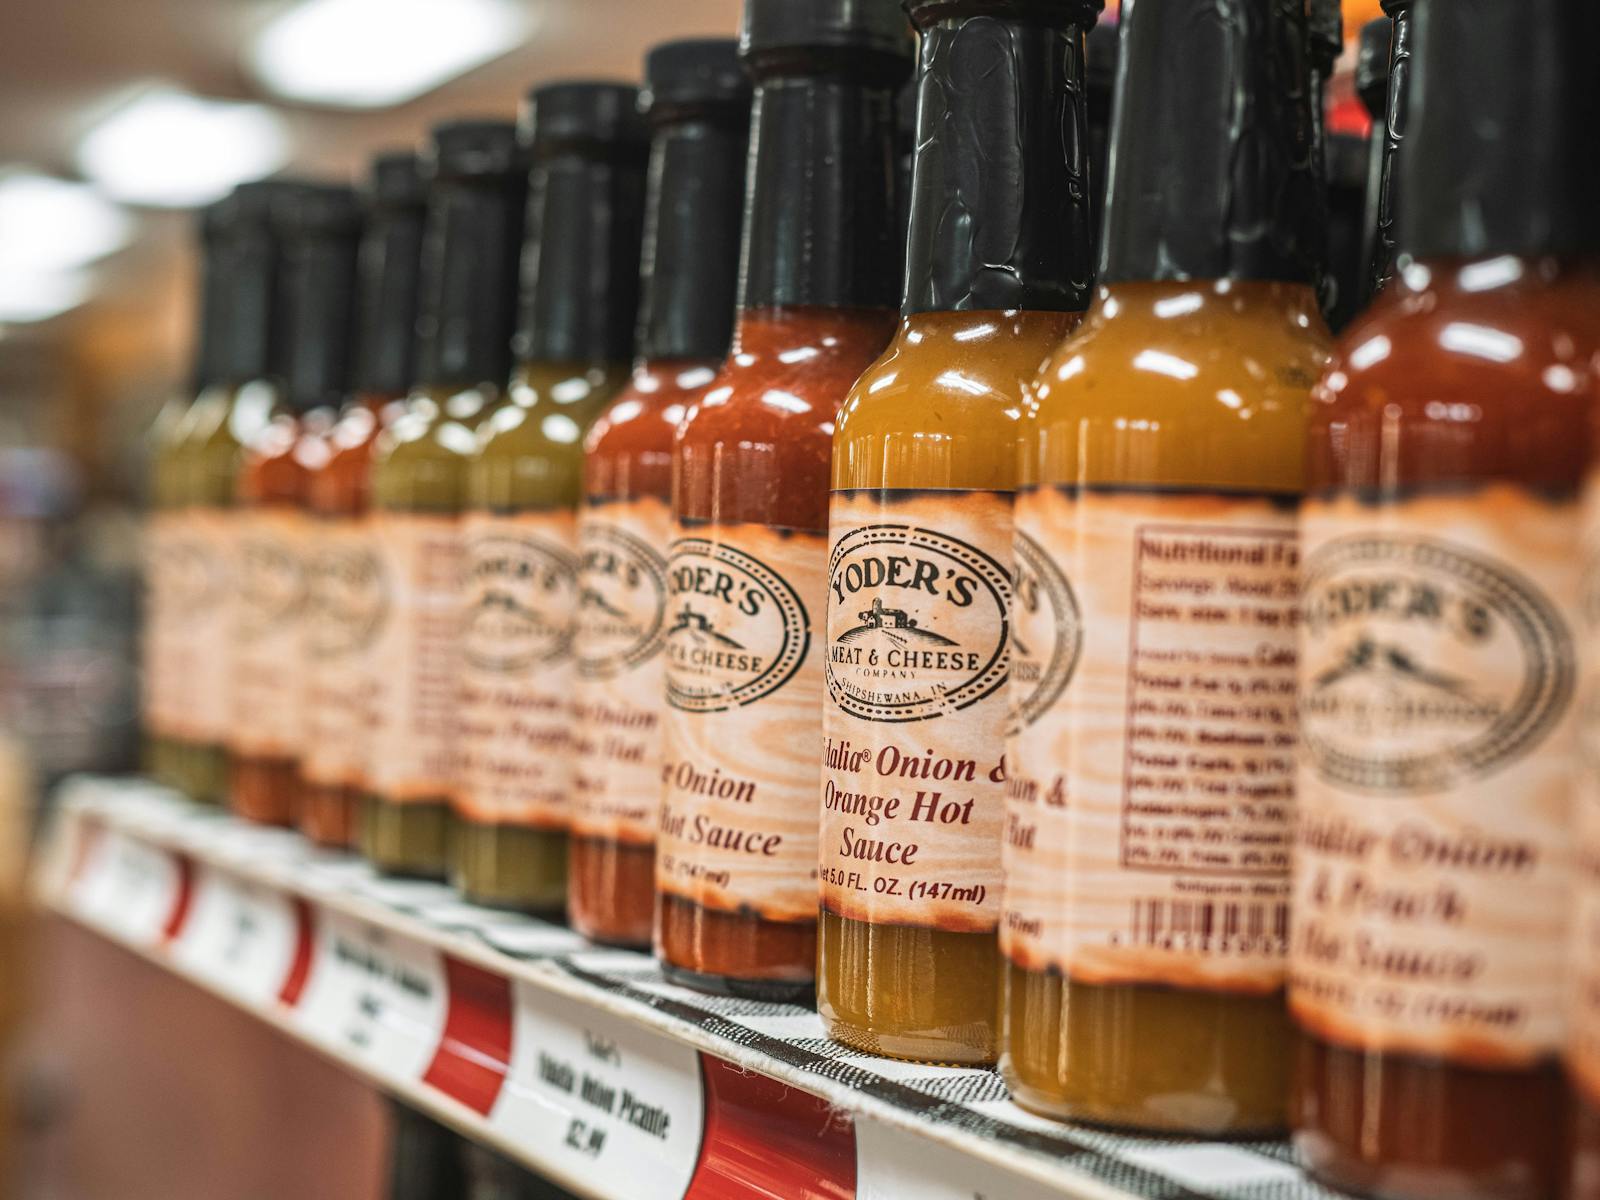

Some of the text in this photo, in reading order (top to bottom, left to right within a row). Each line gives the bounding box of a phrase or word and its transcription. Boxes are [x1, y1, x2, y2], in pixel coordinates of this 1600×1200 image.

[832, 556, 978, 607] YODER'S
[690, 647, 762, 673] CHEESE
[831, 645, 980, 671] MEAT & CHEESE
[856, 667, 916, 679] COMPANY
[930, 682, 947, 696] IN
[676, 762, 756, 802] Onion
[876, 746, 975, 782] Onion
[825, 780, 974, 826] Orange Hot
[689, 814, 782, 856] Sauce
[840, 827, 918, 865] Sauce
[830, 868, 845, 886] 5.0
[847, 872, 867, 891] FL.
[874, 877, 902, 895] OZ.
[909, 881, 986, 904] (147ml)
